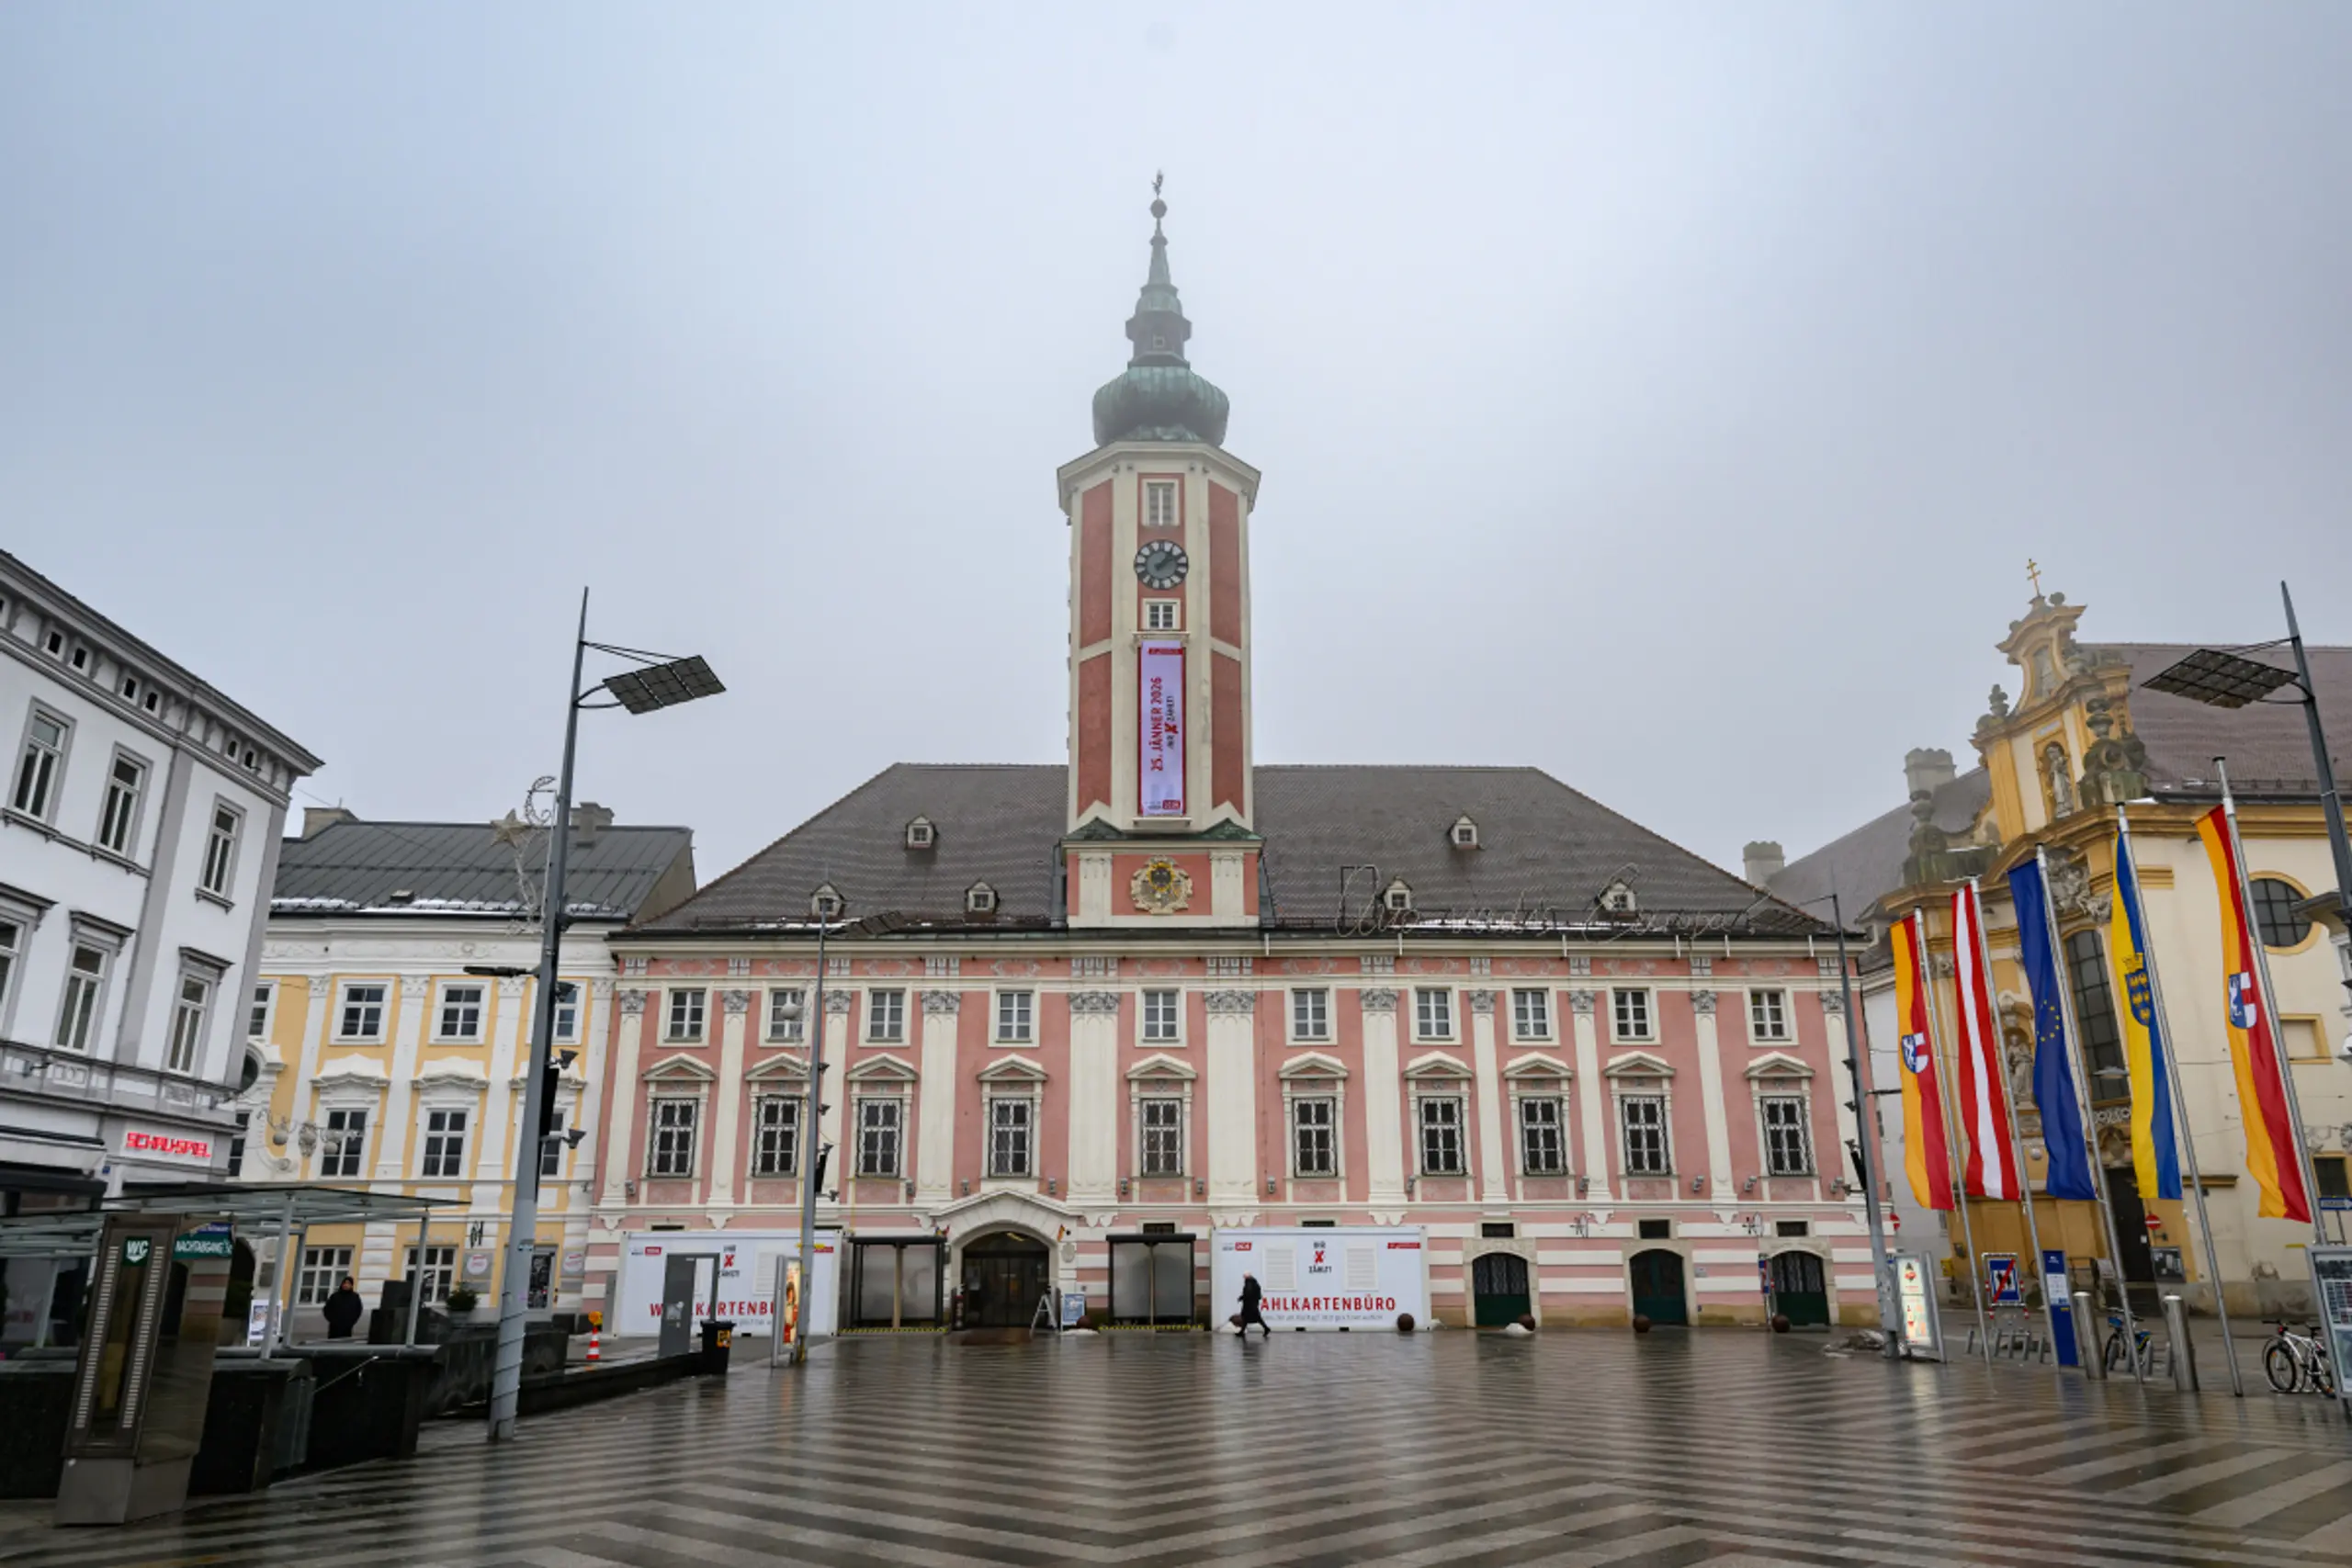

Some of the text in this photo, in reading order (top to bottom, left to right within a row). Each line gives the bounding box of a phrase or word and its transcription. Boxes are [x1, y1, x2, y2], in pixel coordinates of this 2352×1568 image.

[1148, 676, 1163, 772] 25. JÄNNER 2026
[127, 1131, 211, 1158] SCHAUSPIEL
[127, 1240, 149, 1257] WC
[1260, 1293, 1396, 1312] AHLKARTENBÜRO
